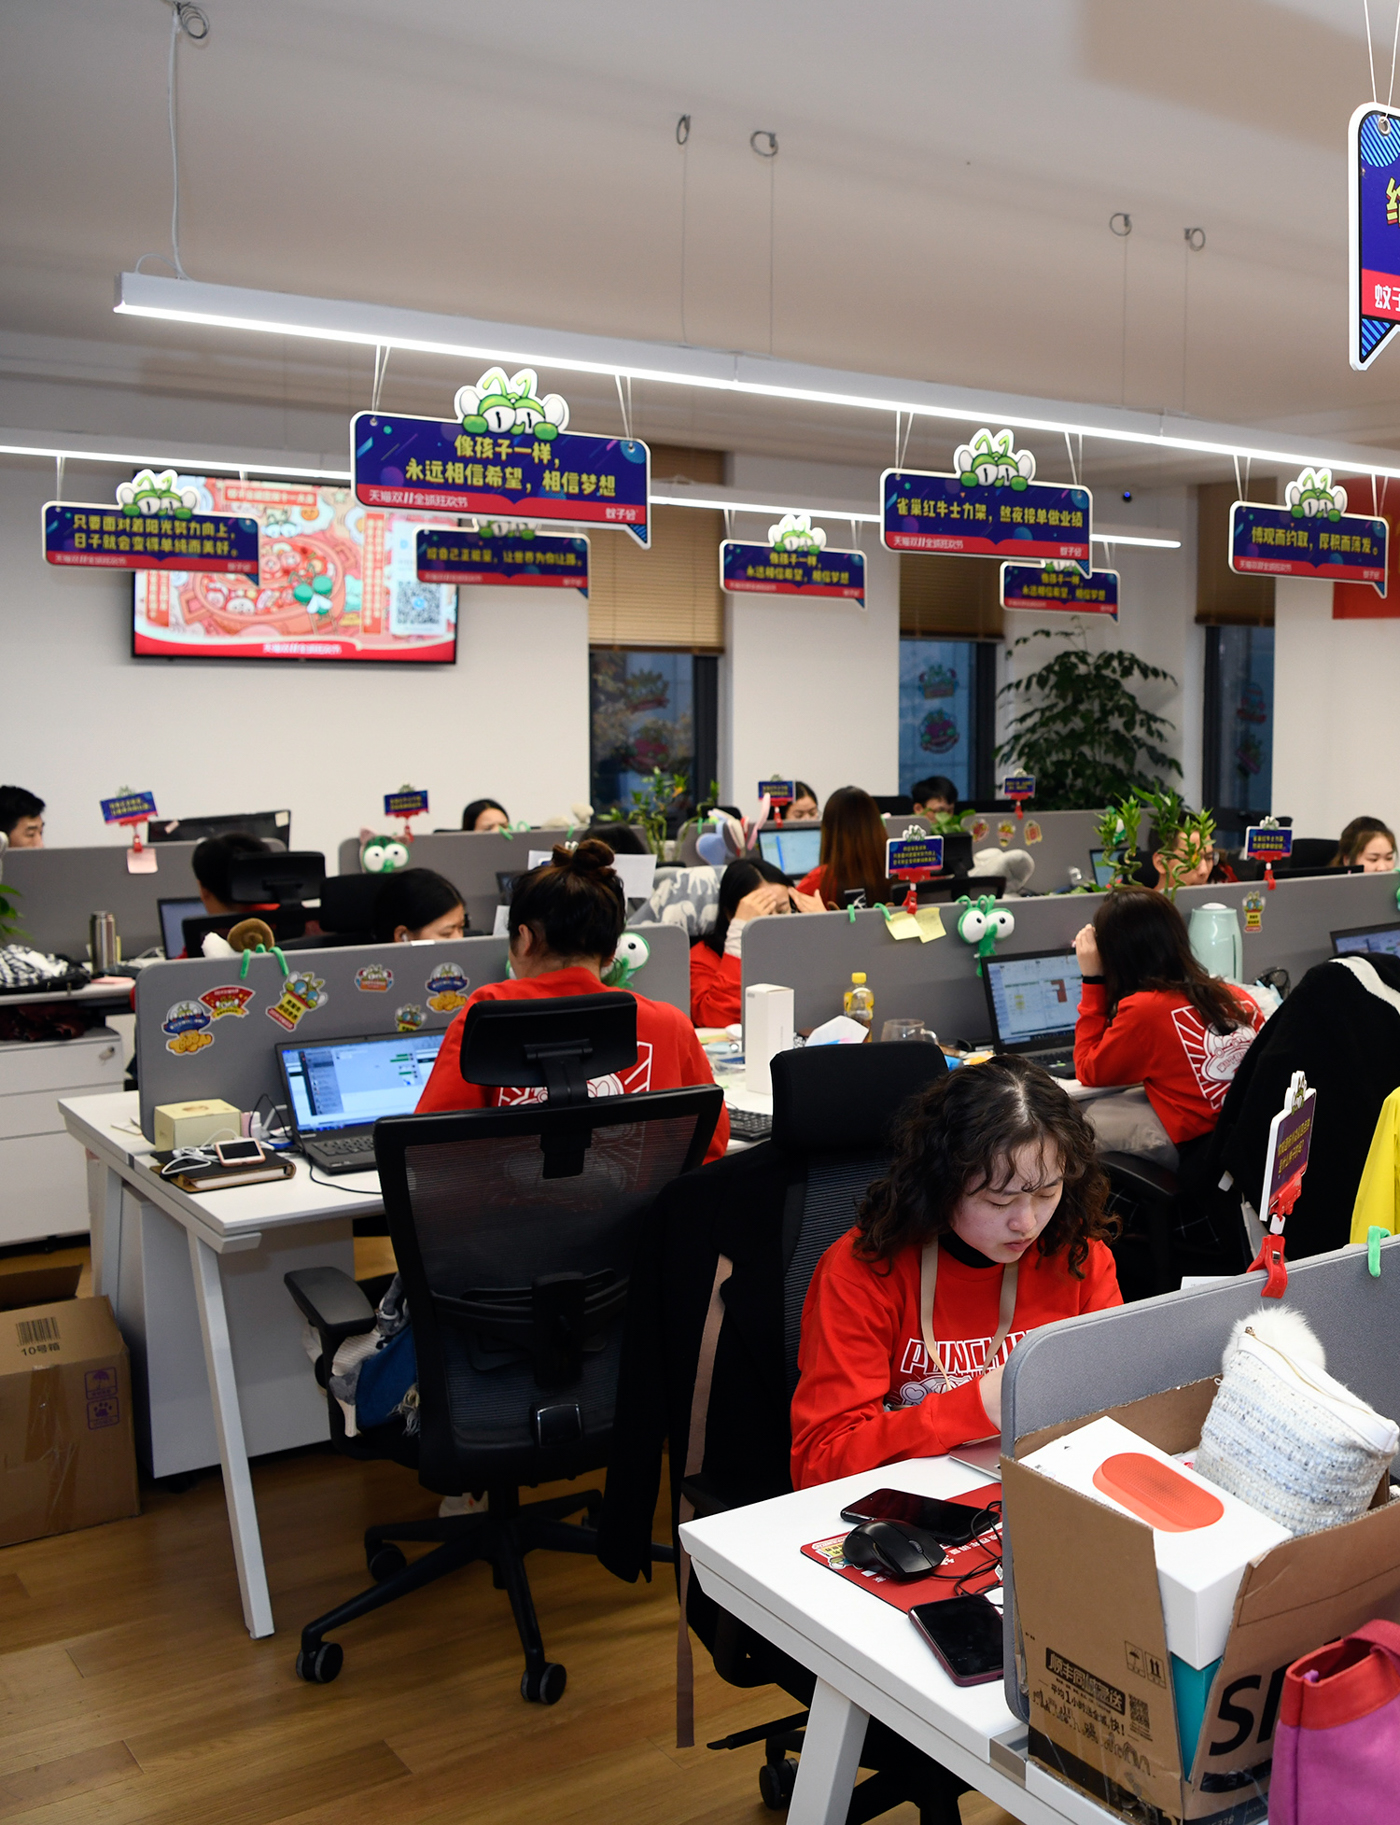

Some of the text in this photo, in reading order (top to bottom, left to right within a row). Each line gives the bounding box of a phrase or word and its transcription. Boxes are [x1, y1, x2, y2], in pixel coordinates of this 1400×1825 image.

[454, 434, 560, 468] 像孩子一样，
[405, 457, 616, 498] 永远相信希望，相信梦想
[20, 1342, 61, 1357] 10号箱
